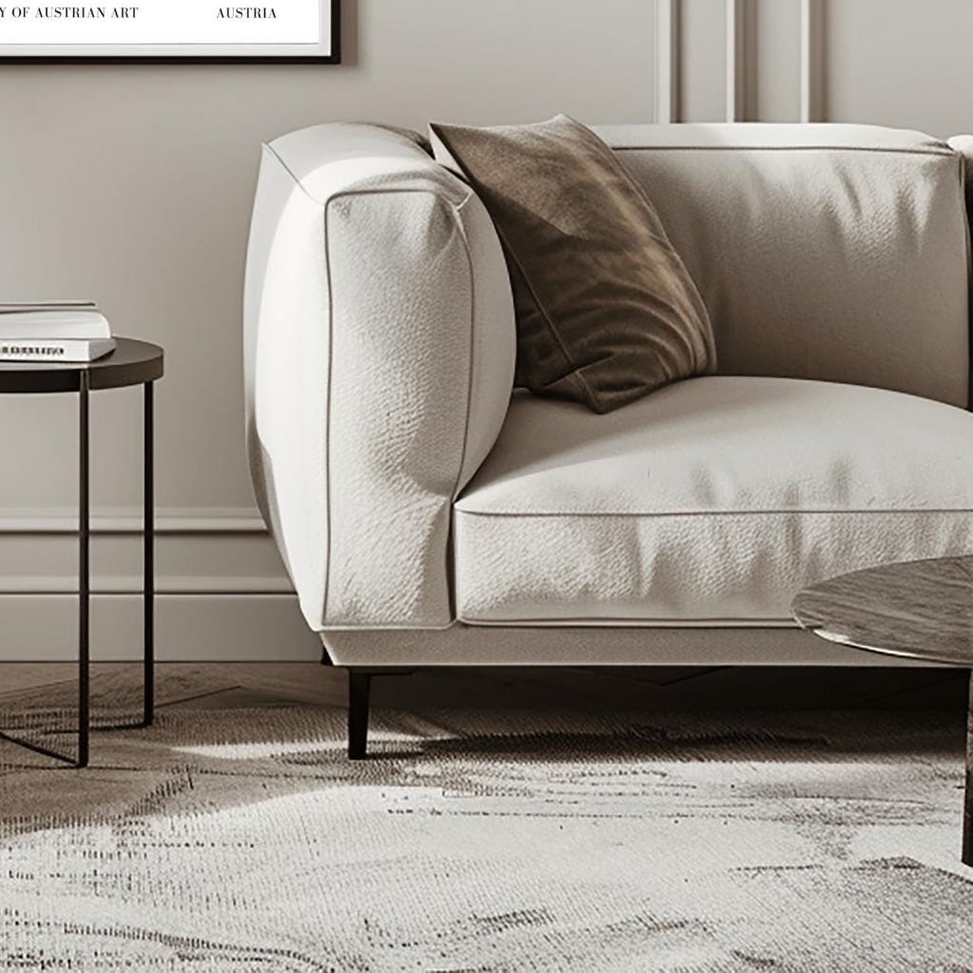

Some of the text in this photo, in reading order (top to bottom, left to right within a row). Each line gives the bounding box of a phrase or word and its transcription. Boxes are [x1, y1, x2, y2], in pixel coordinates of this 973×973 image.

[11, 6, 31, 19] OF
[35, 6, 106, 19] AUSTRIAN
[113, 6, 139, 19] ART
[217, 6, 277, 19] AUSTRIA
